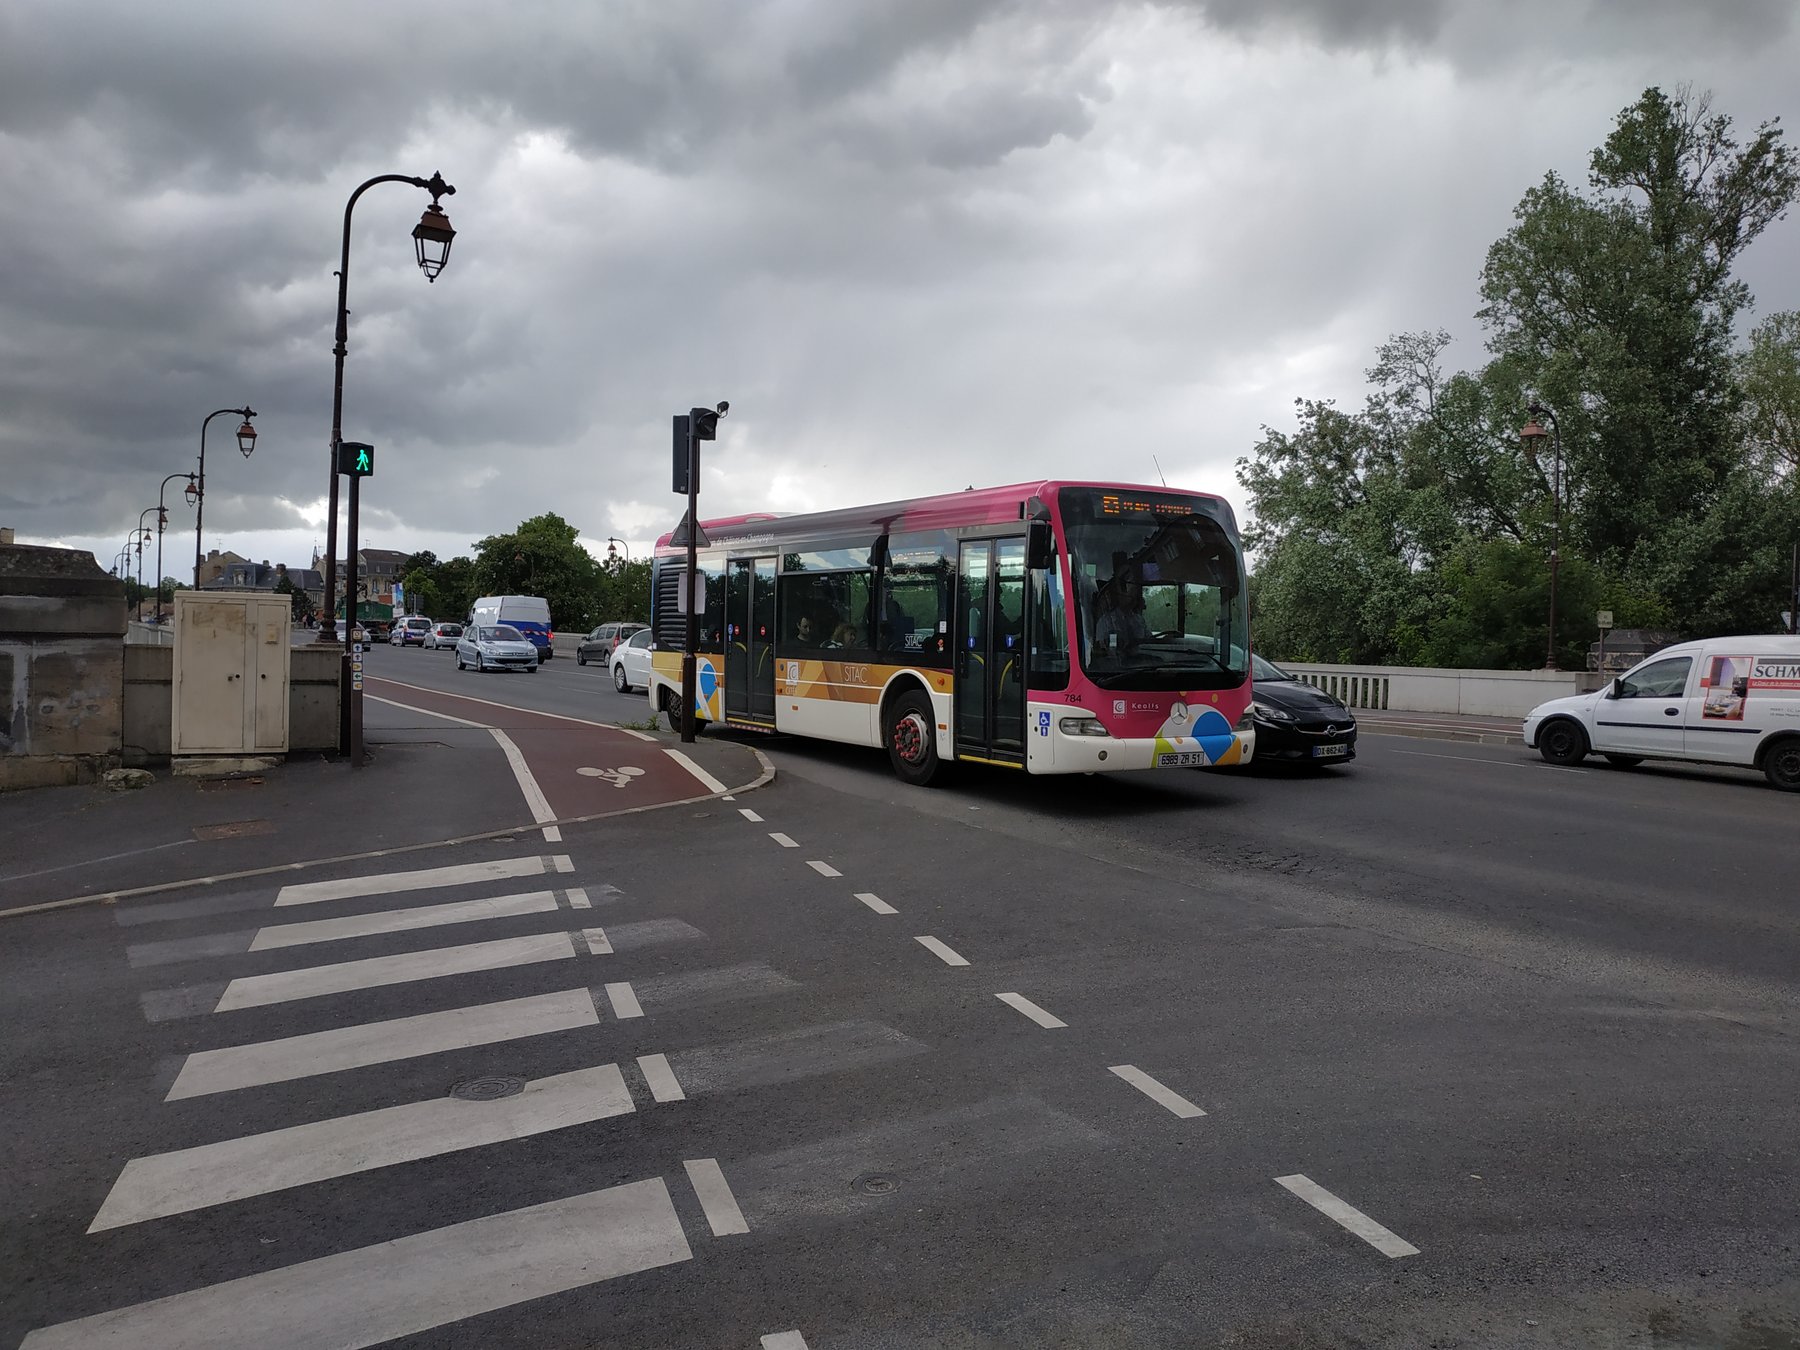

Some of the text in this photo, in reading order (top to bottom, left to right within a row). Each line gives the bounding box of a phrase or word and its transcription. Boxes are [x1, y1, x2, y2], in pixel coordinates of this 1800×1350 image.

[905, 635, 923, 647] SITAC
[844, 666, 869, 683] SITAC
[1064, 693, 1082, 703] 784
[1131, 702, 1160, 710] Keolis
